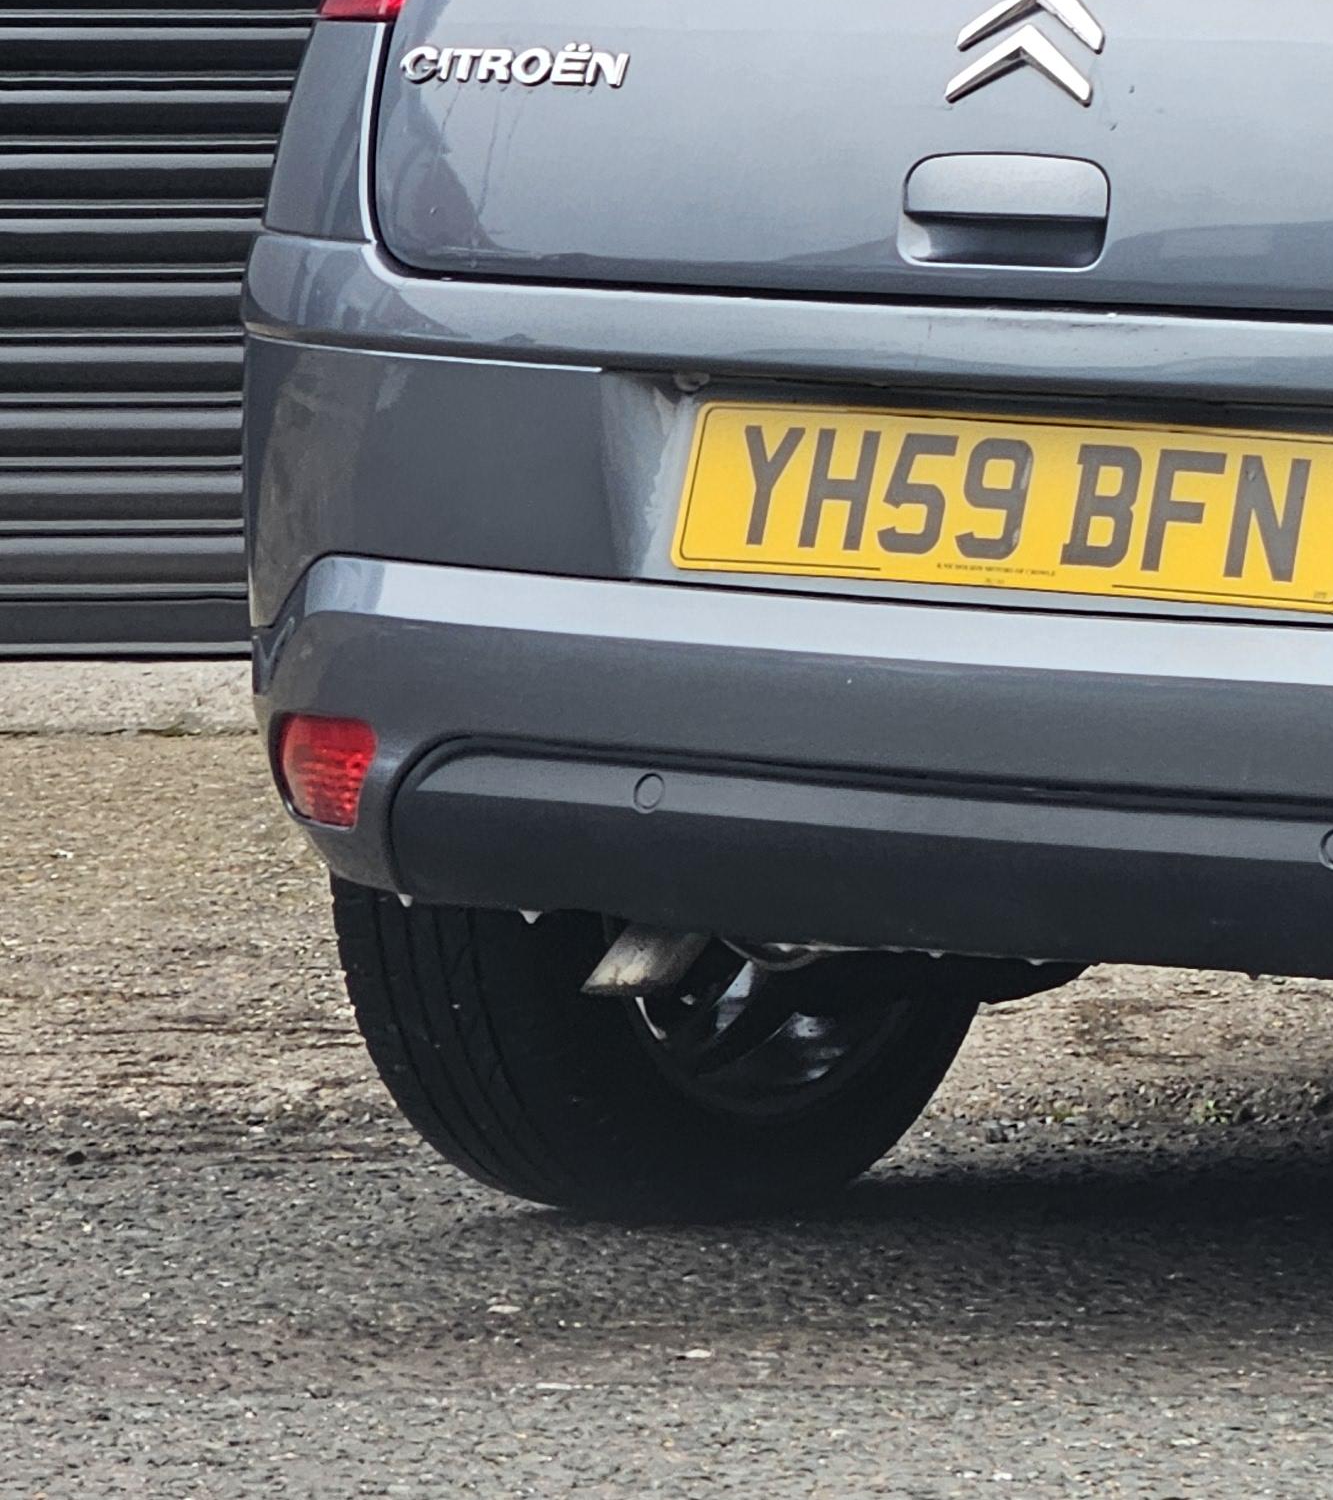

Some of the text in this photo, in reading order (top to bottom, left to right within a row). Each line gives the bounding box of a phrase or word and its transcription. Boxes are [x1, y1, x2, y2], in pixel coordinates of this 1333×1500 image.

[400, 43, 630, 87] CITROËN
[744, 424, 1312, 583] YH59 BFN
